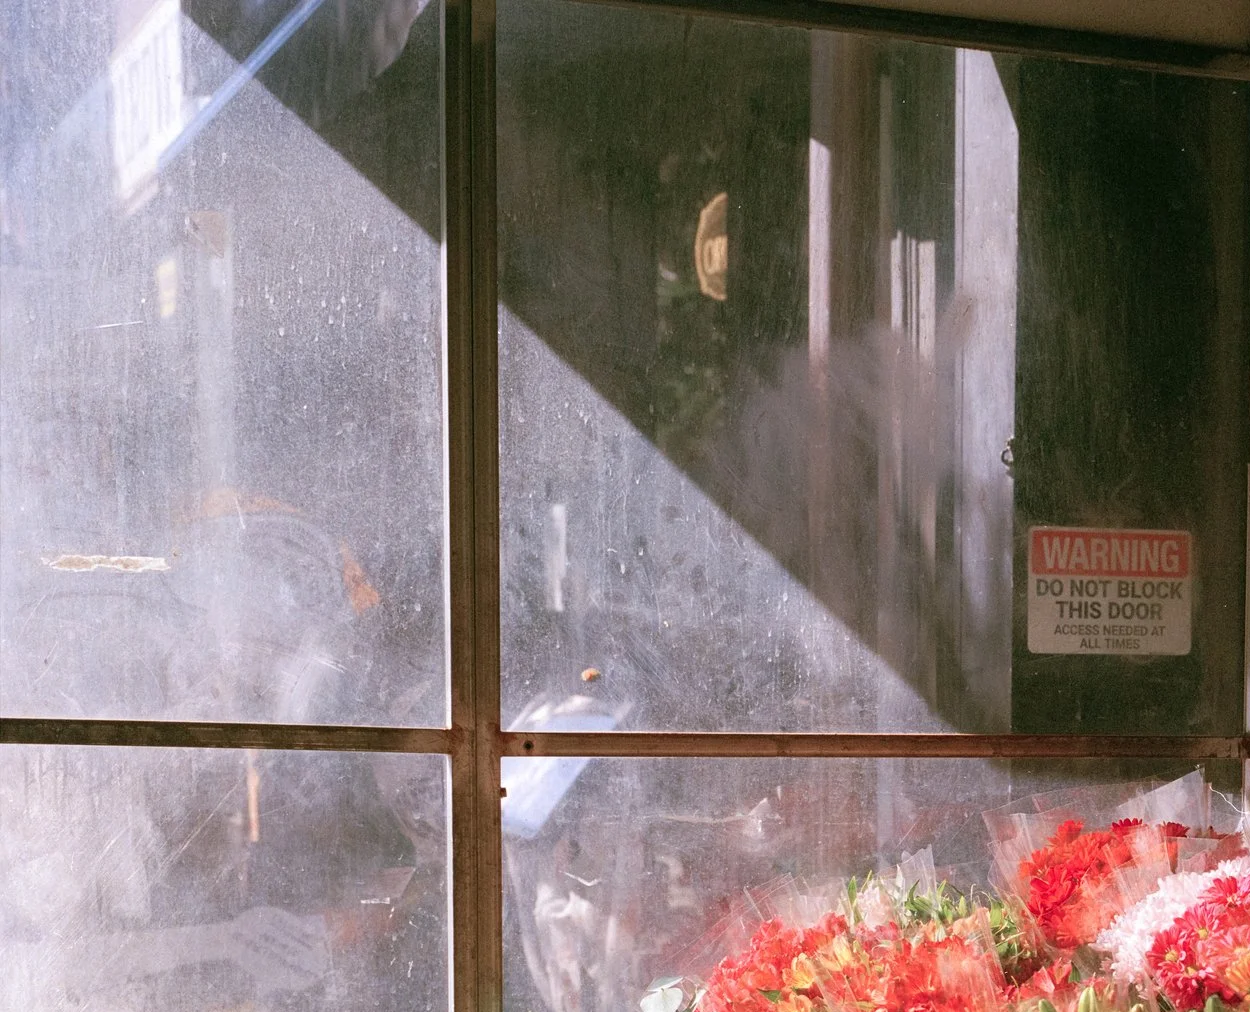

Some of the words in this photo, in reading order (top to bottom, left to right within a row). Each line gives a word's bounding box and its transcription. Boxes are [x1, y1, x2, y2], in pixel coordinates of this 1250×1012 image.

[1042, 535, 1180, 573] WARNING
[1036, 579, 1063, 597] DO
[1070, 579, 1112, 598] NOT
[1117, 580, 1183, 599] BLOCK
[1055, 601, 1101, 620] THIS
[1108, 602, 1163, 620] DOOR
[1054, 624, 1100, 636] ACCESS
[1103, 625, 1148, 636] NEEDED
[1151, 626, 1166, 636] AT
[1080, 638, 1100, 649] ALL
[1104, 638, 1140, 650] TIMES
